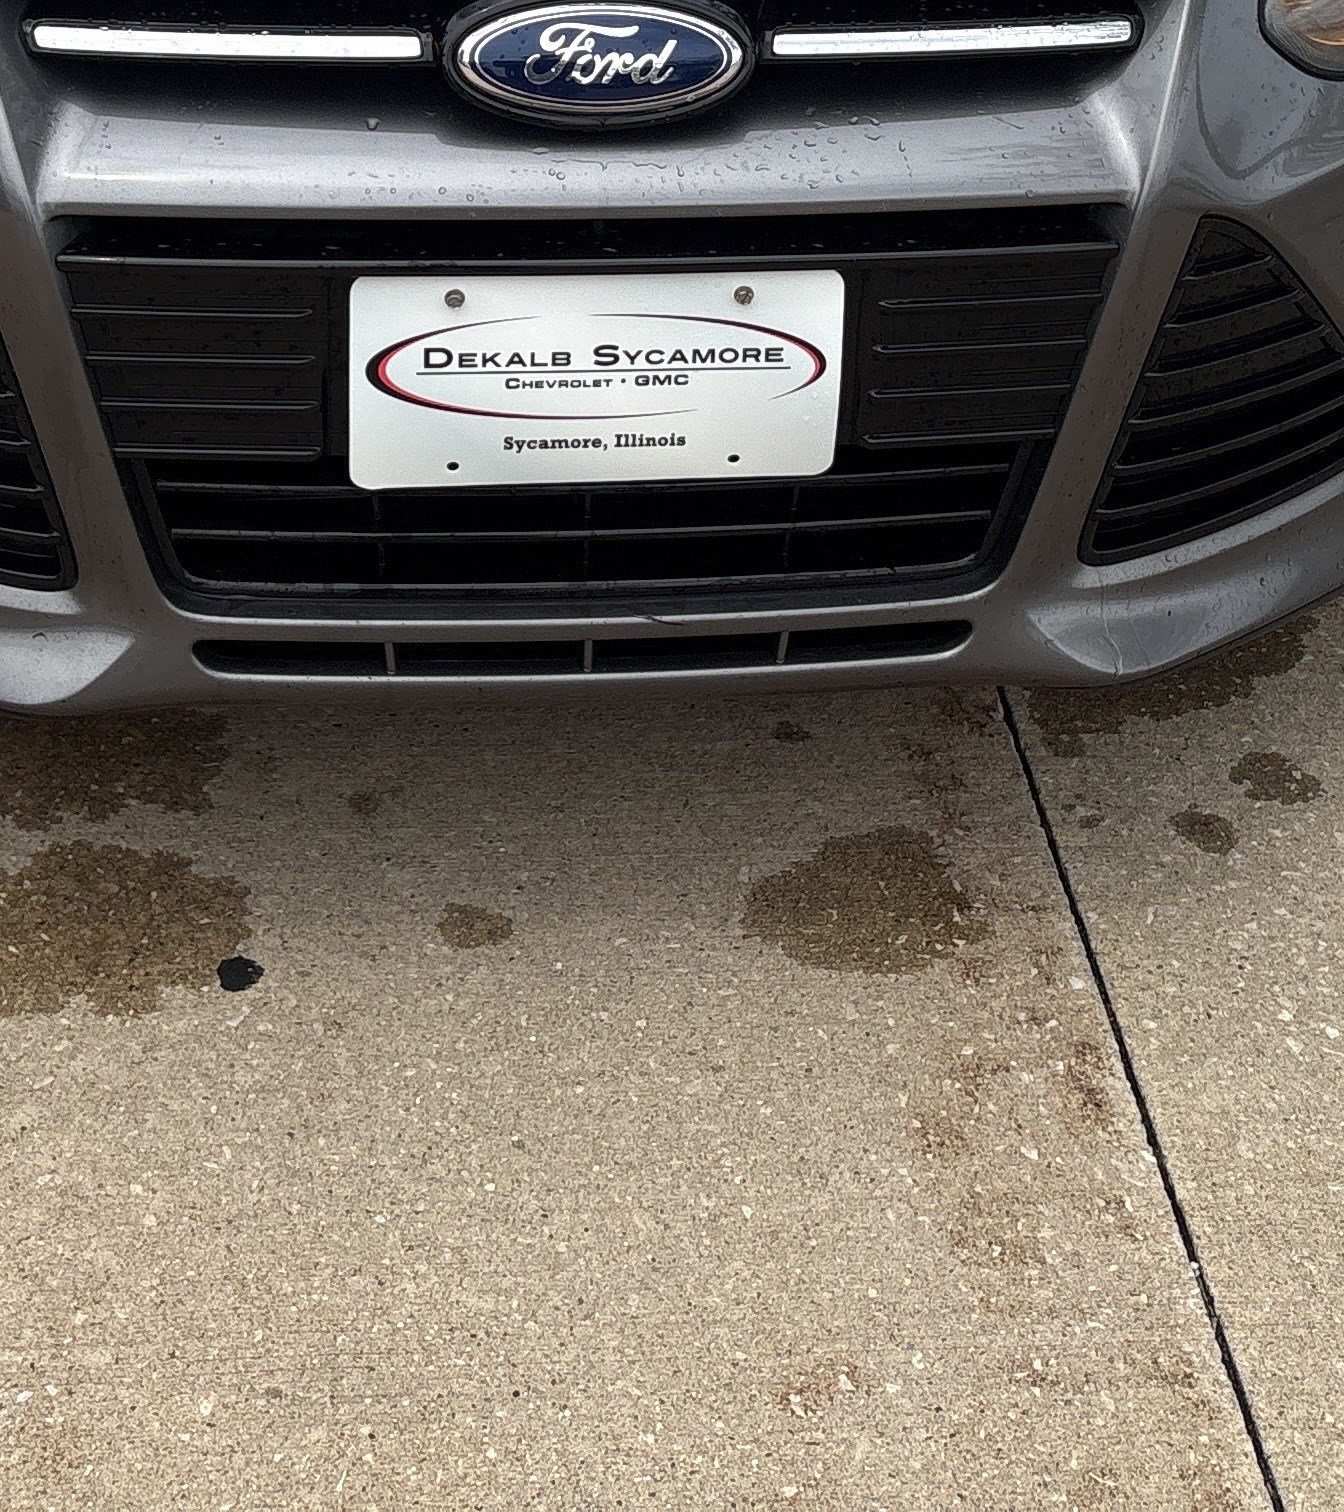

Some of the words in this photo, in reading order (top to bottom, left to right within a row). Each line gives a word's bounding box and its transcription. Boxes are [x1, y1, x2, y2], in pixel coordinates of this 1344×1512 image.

[524, 21, 678, 85] Ford
[423, 347, 572, 369] DEKALB
[592, 344, 785, 366] SYCAMORE
[505, 377, 613, 390] CHEVROLET
[634, 374, 690, 387] GMC
[503, 436, 608, 453] Sycamore,
[614, 432, 687, 448] Illinois
